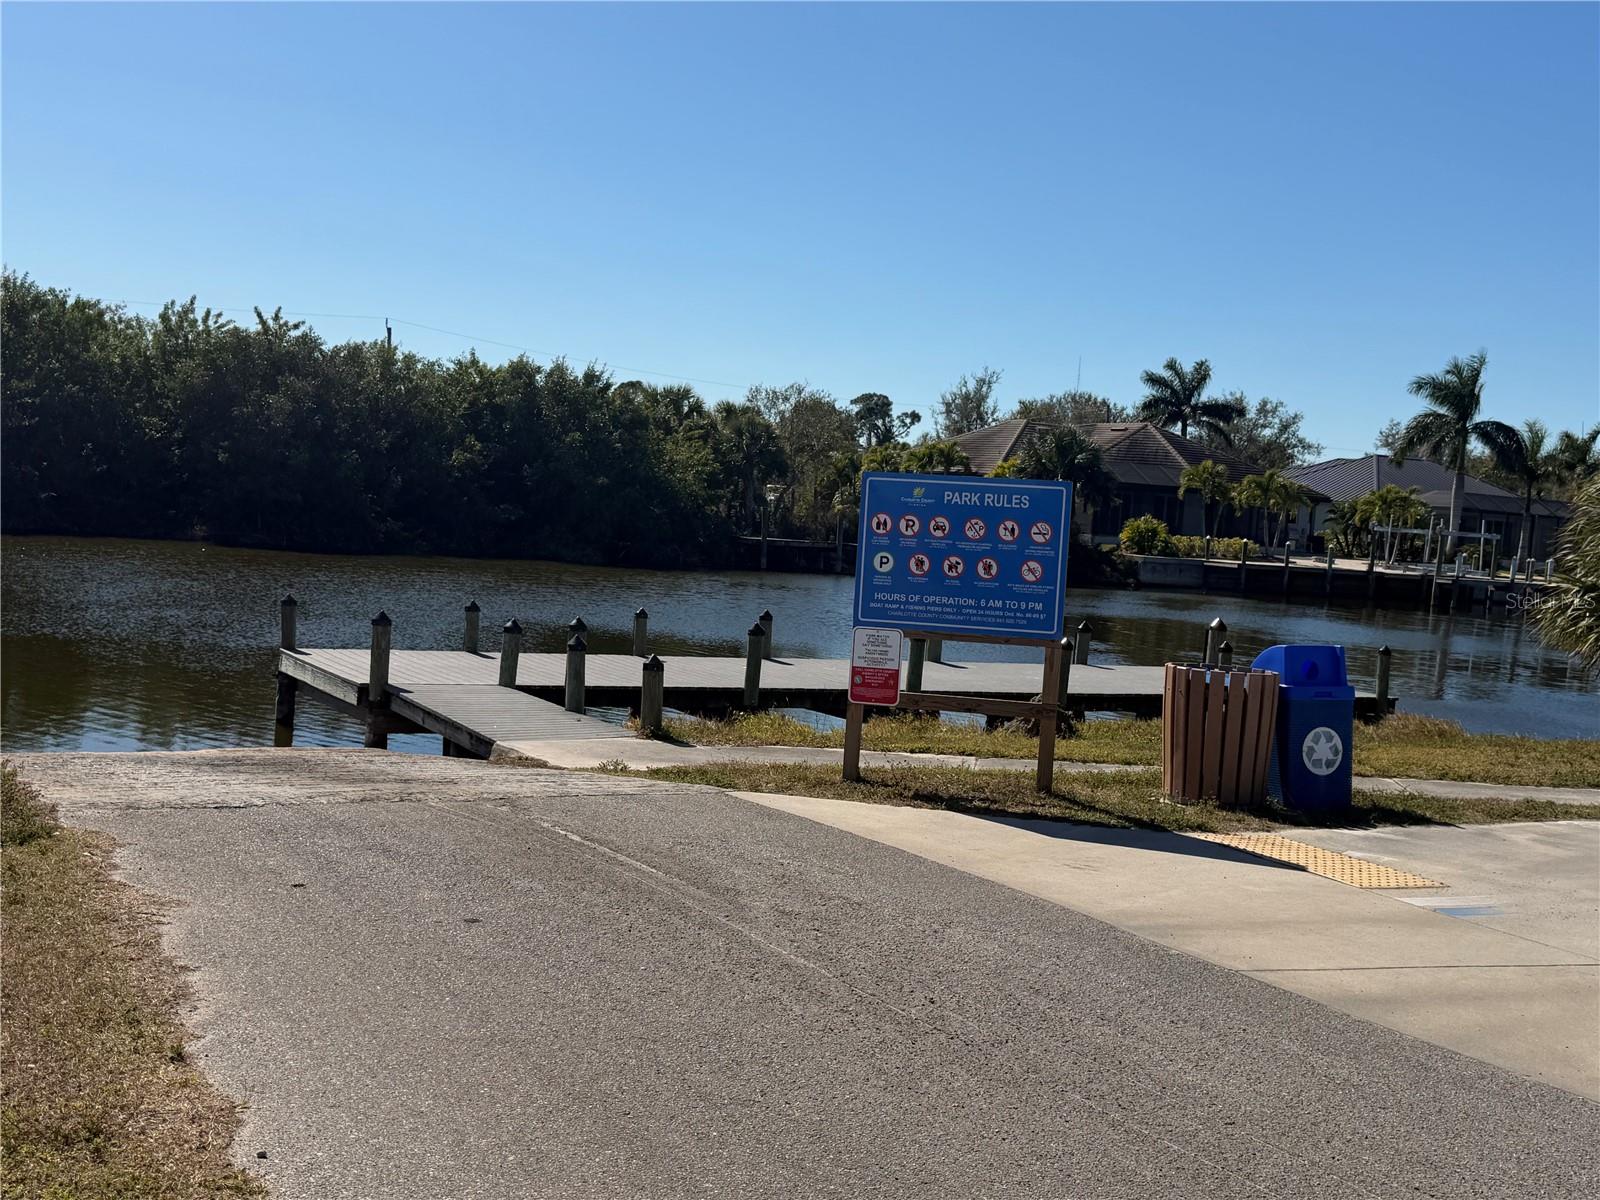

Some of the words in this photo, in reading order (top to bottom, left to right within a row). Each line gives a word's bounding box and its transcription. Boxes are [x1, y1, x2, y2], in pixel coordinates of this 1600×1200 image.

[944, 491, 980, 506] PARK
[984, 493, 1030, 509] RULES
[874, 592, 906, 602] HOURS
[908, 594, 921, 602] OF
[923, 595, 978, 606] OPERATION:
[980, 598, 986, 607] 6
[987, 599, 1002, 608] AM
[1005, 600, 1018, 609] TO
[1020, 601, 1026, 609] 9
[1027, 602, 1043, 610] PM
